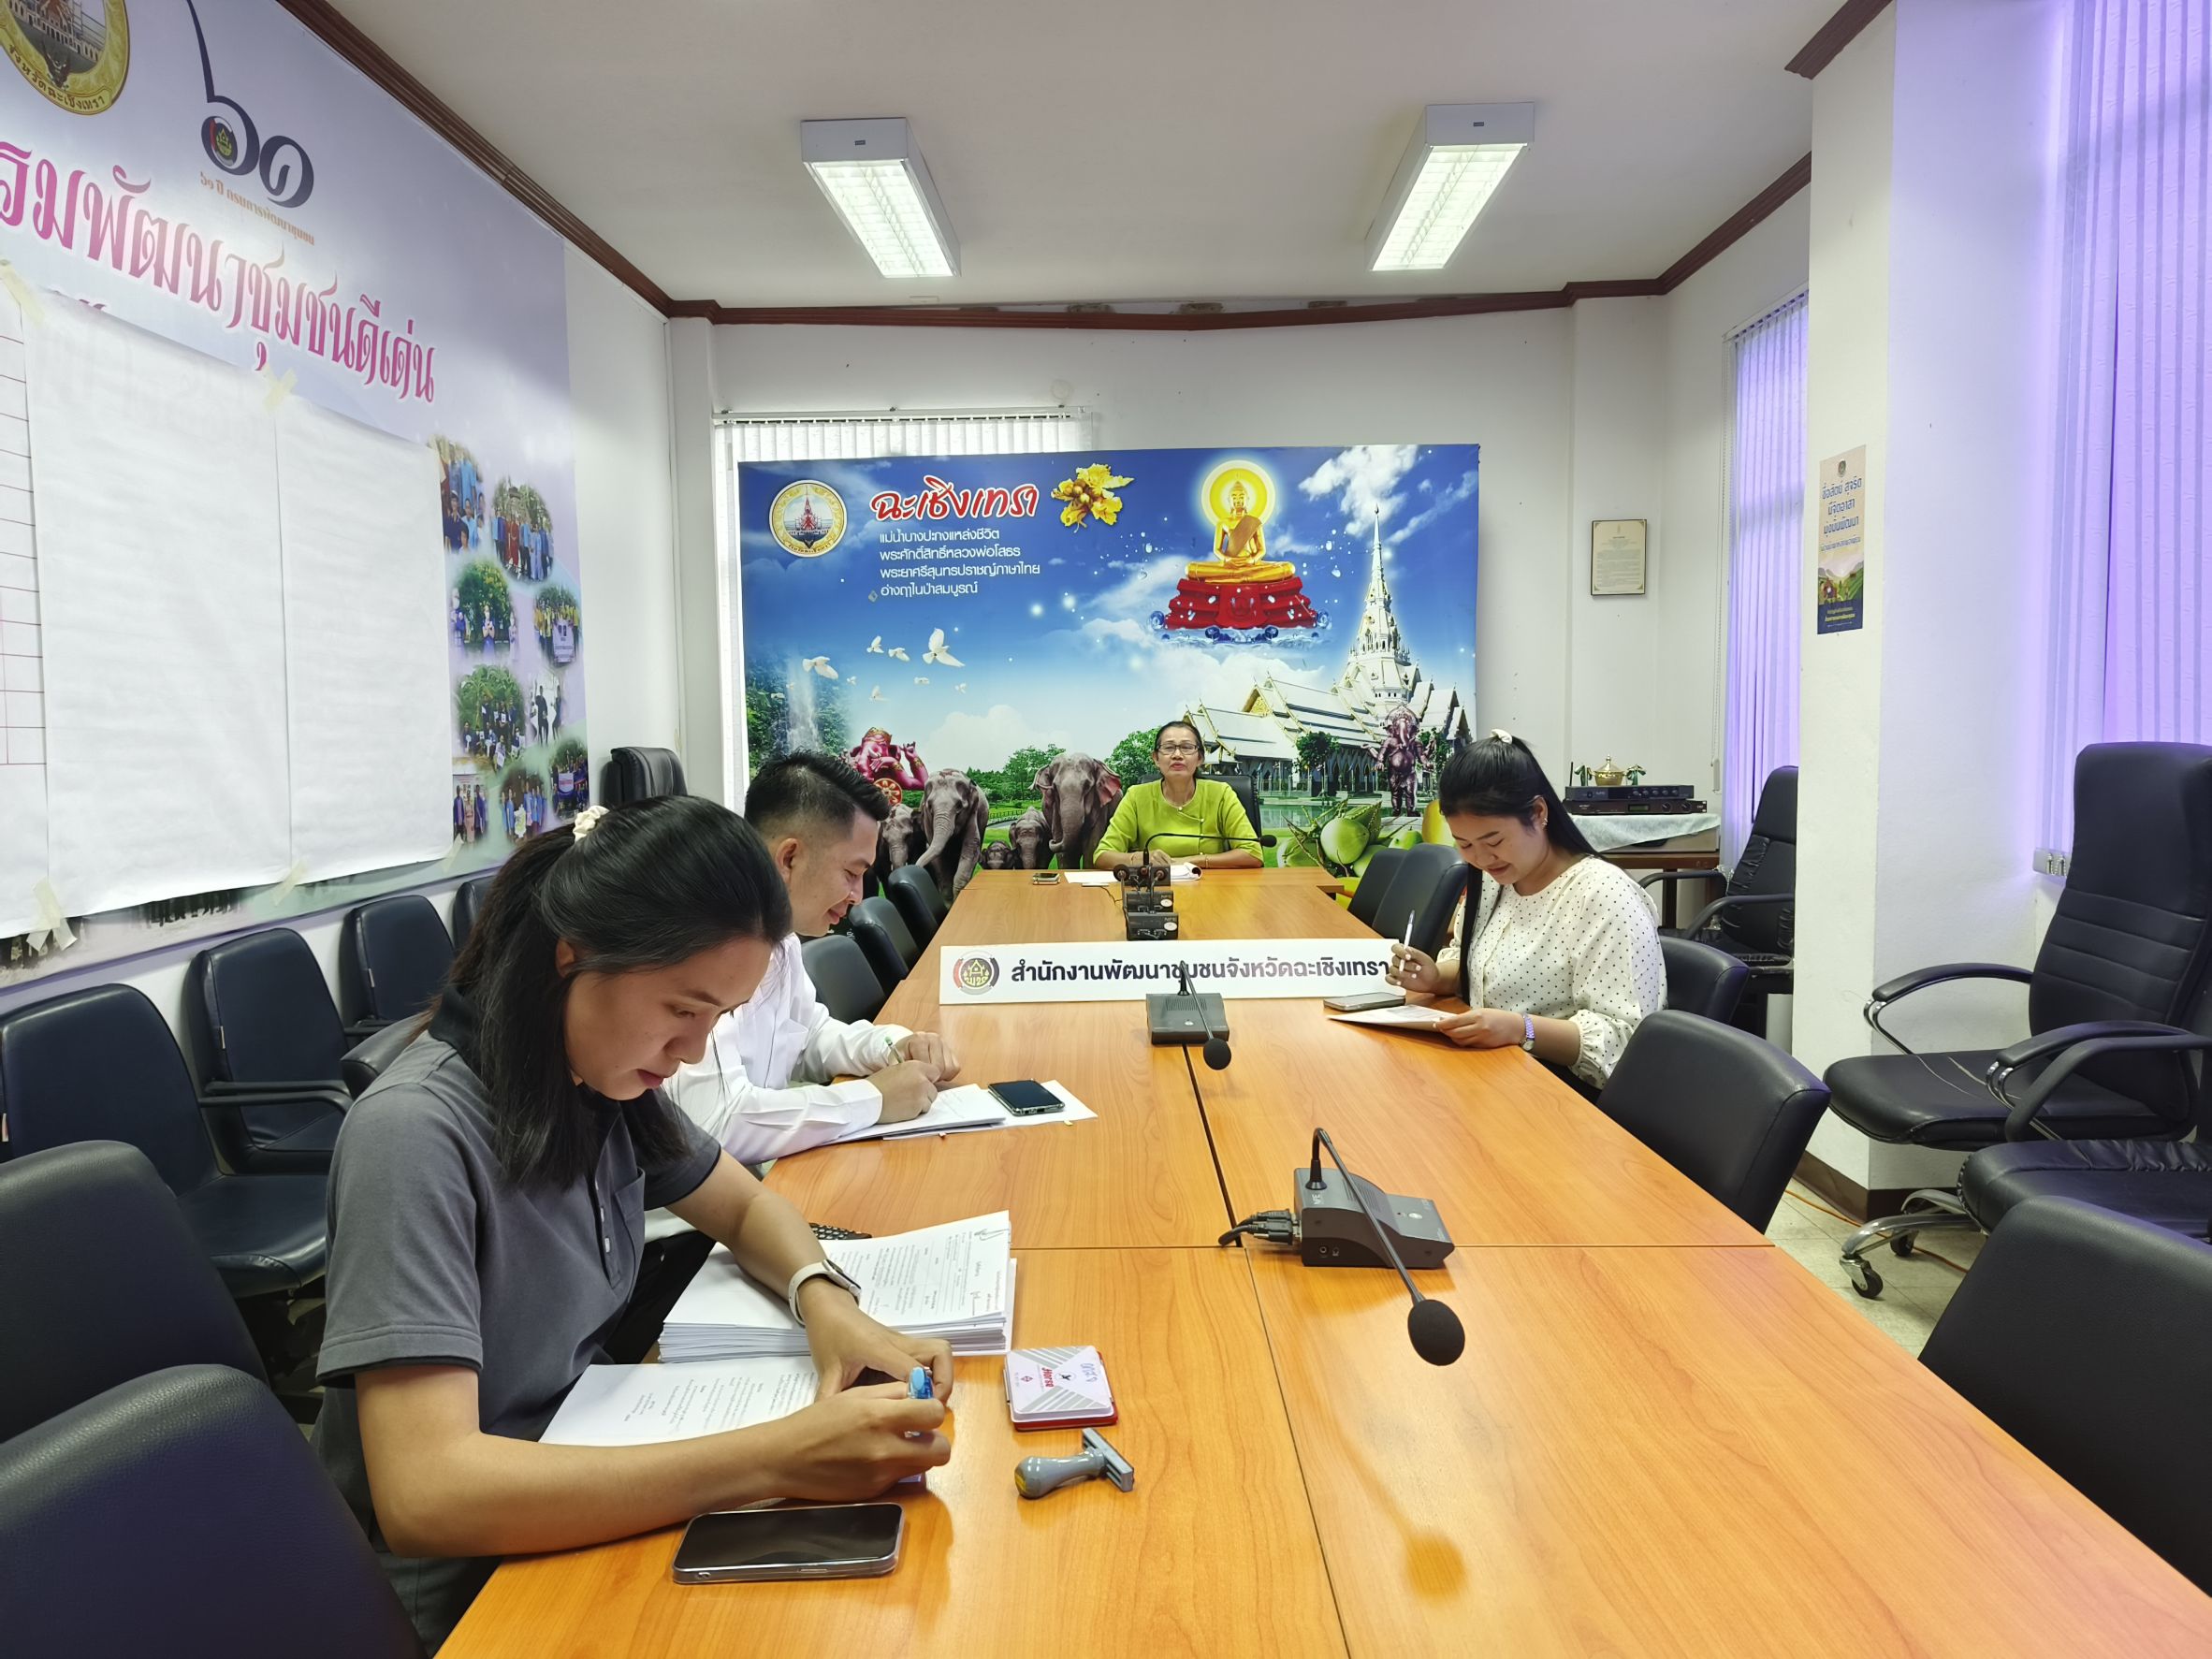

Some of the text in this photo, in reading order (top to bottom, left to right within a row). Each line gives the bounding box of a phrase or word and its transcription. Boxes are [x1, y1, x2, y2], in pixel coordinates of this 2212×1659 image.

[870, 475, 1039, 520] ฉะเชิงเทรา
[880, 528, 1000, 544] แม่น้ำบางปะกงแหล่งชีวิต
[880, 544, 1021, 561] พระศักดิ์สิทธิ์หลวงพ่อโสธร
[880, 561, 1041, 580] พระยาศรีสุนทรปราชญ์ภาษาไทย
[1041, 1367, 1055, 1388] Horse
